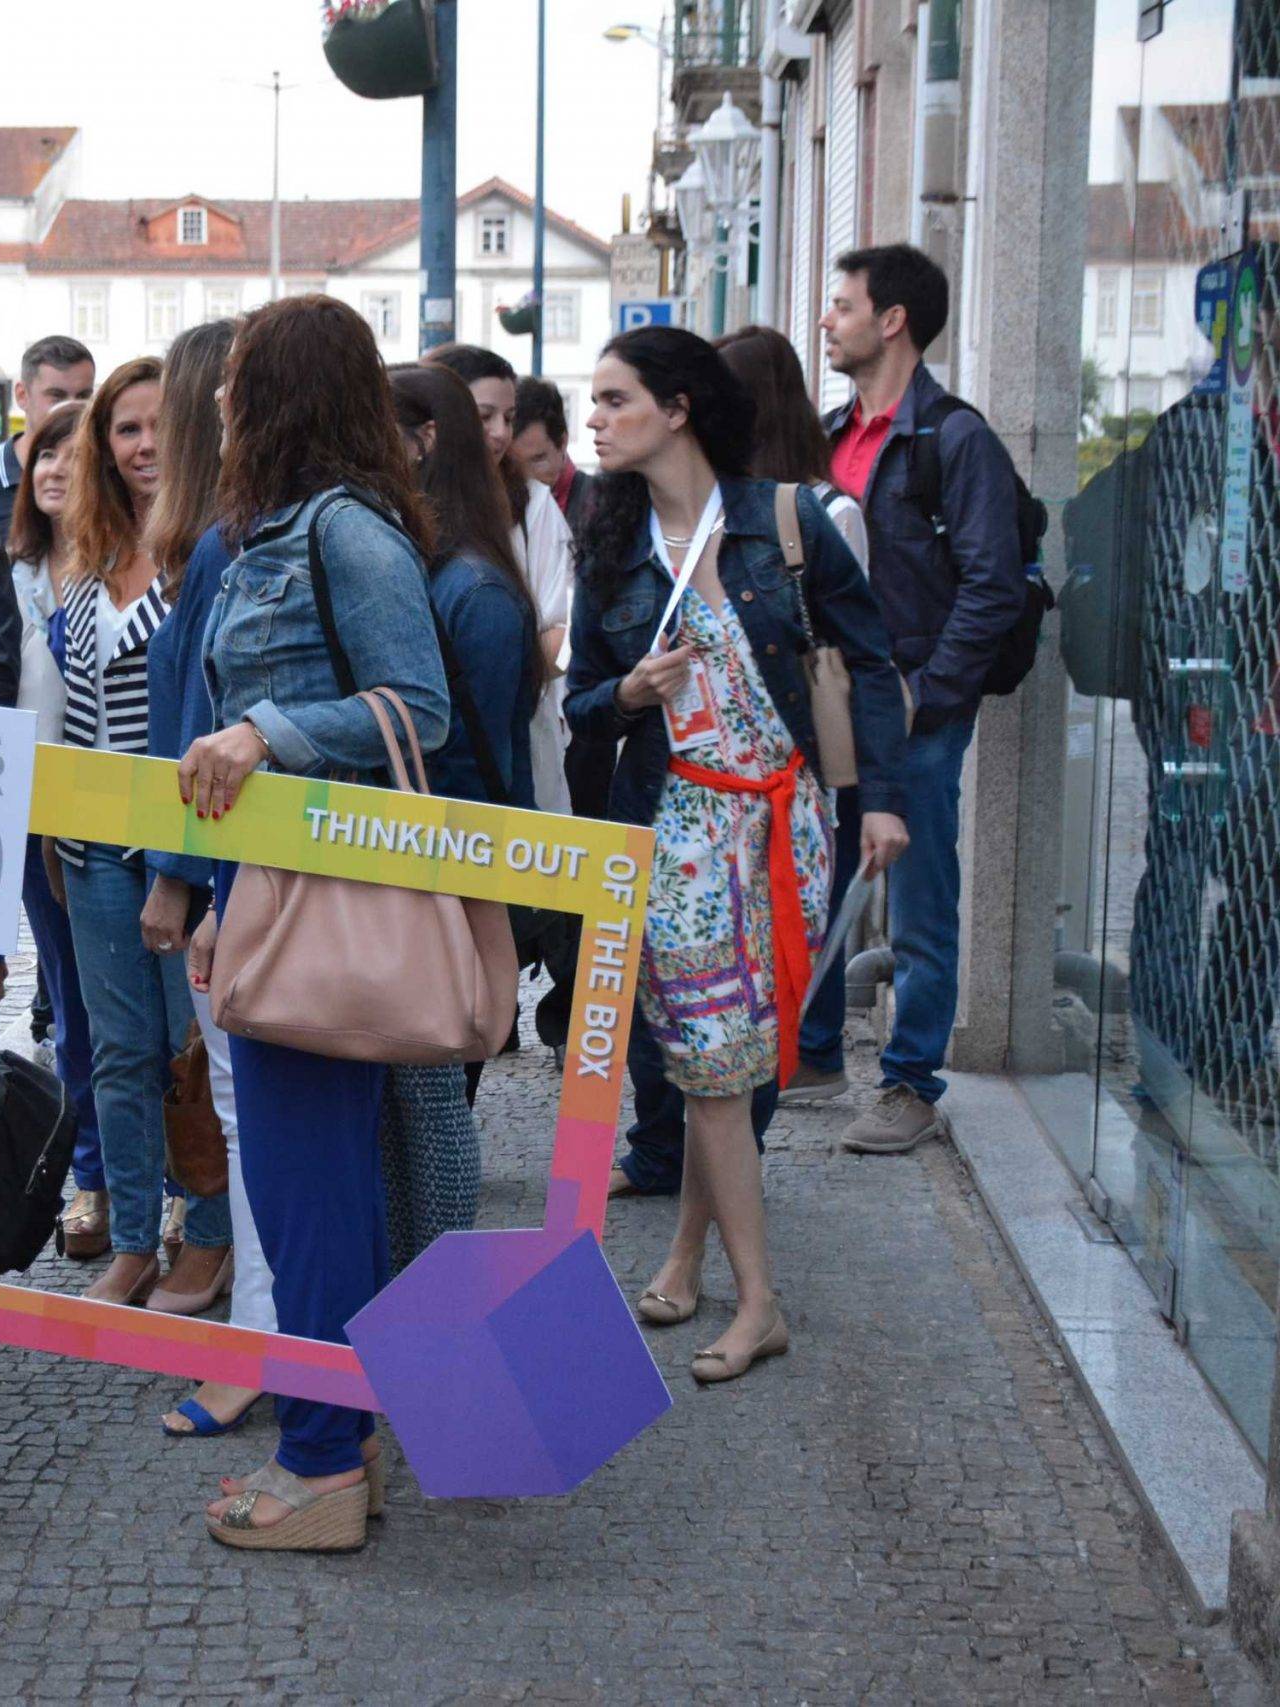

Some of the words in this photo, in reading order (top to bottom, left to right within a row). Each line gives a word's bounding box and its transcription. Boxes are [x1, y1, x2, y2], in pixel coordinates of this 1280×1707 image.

[624, 306, 652, 332] P
[306, 807, 494, 866] THINKING
[505, 838, 587, 878] OUT
[601, 854, 638, 909] OF
[588, 917, 629, 994] THE
[576, 1003, 618, 1081] BOX
